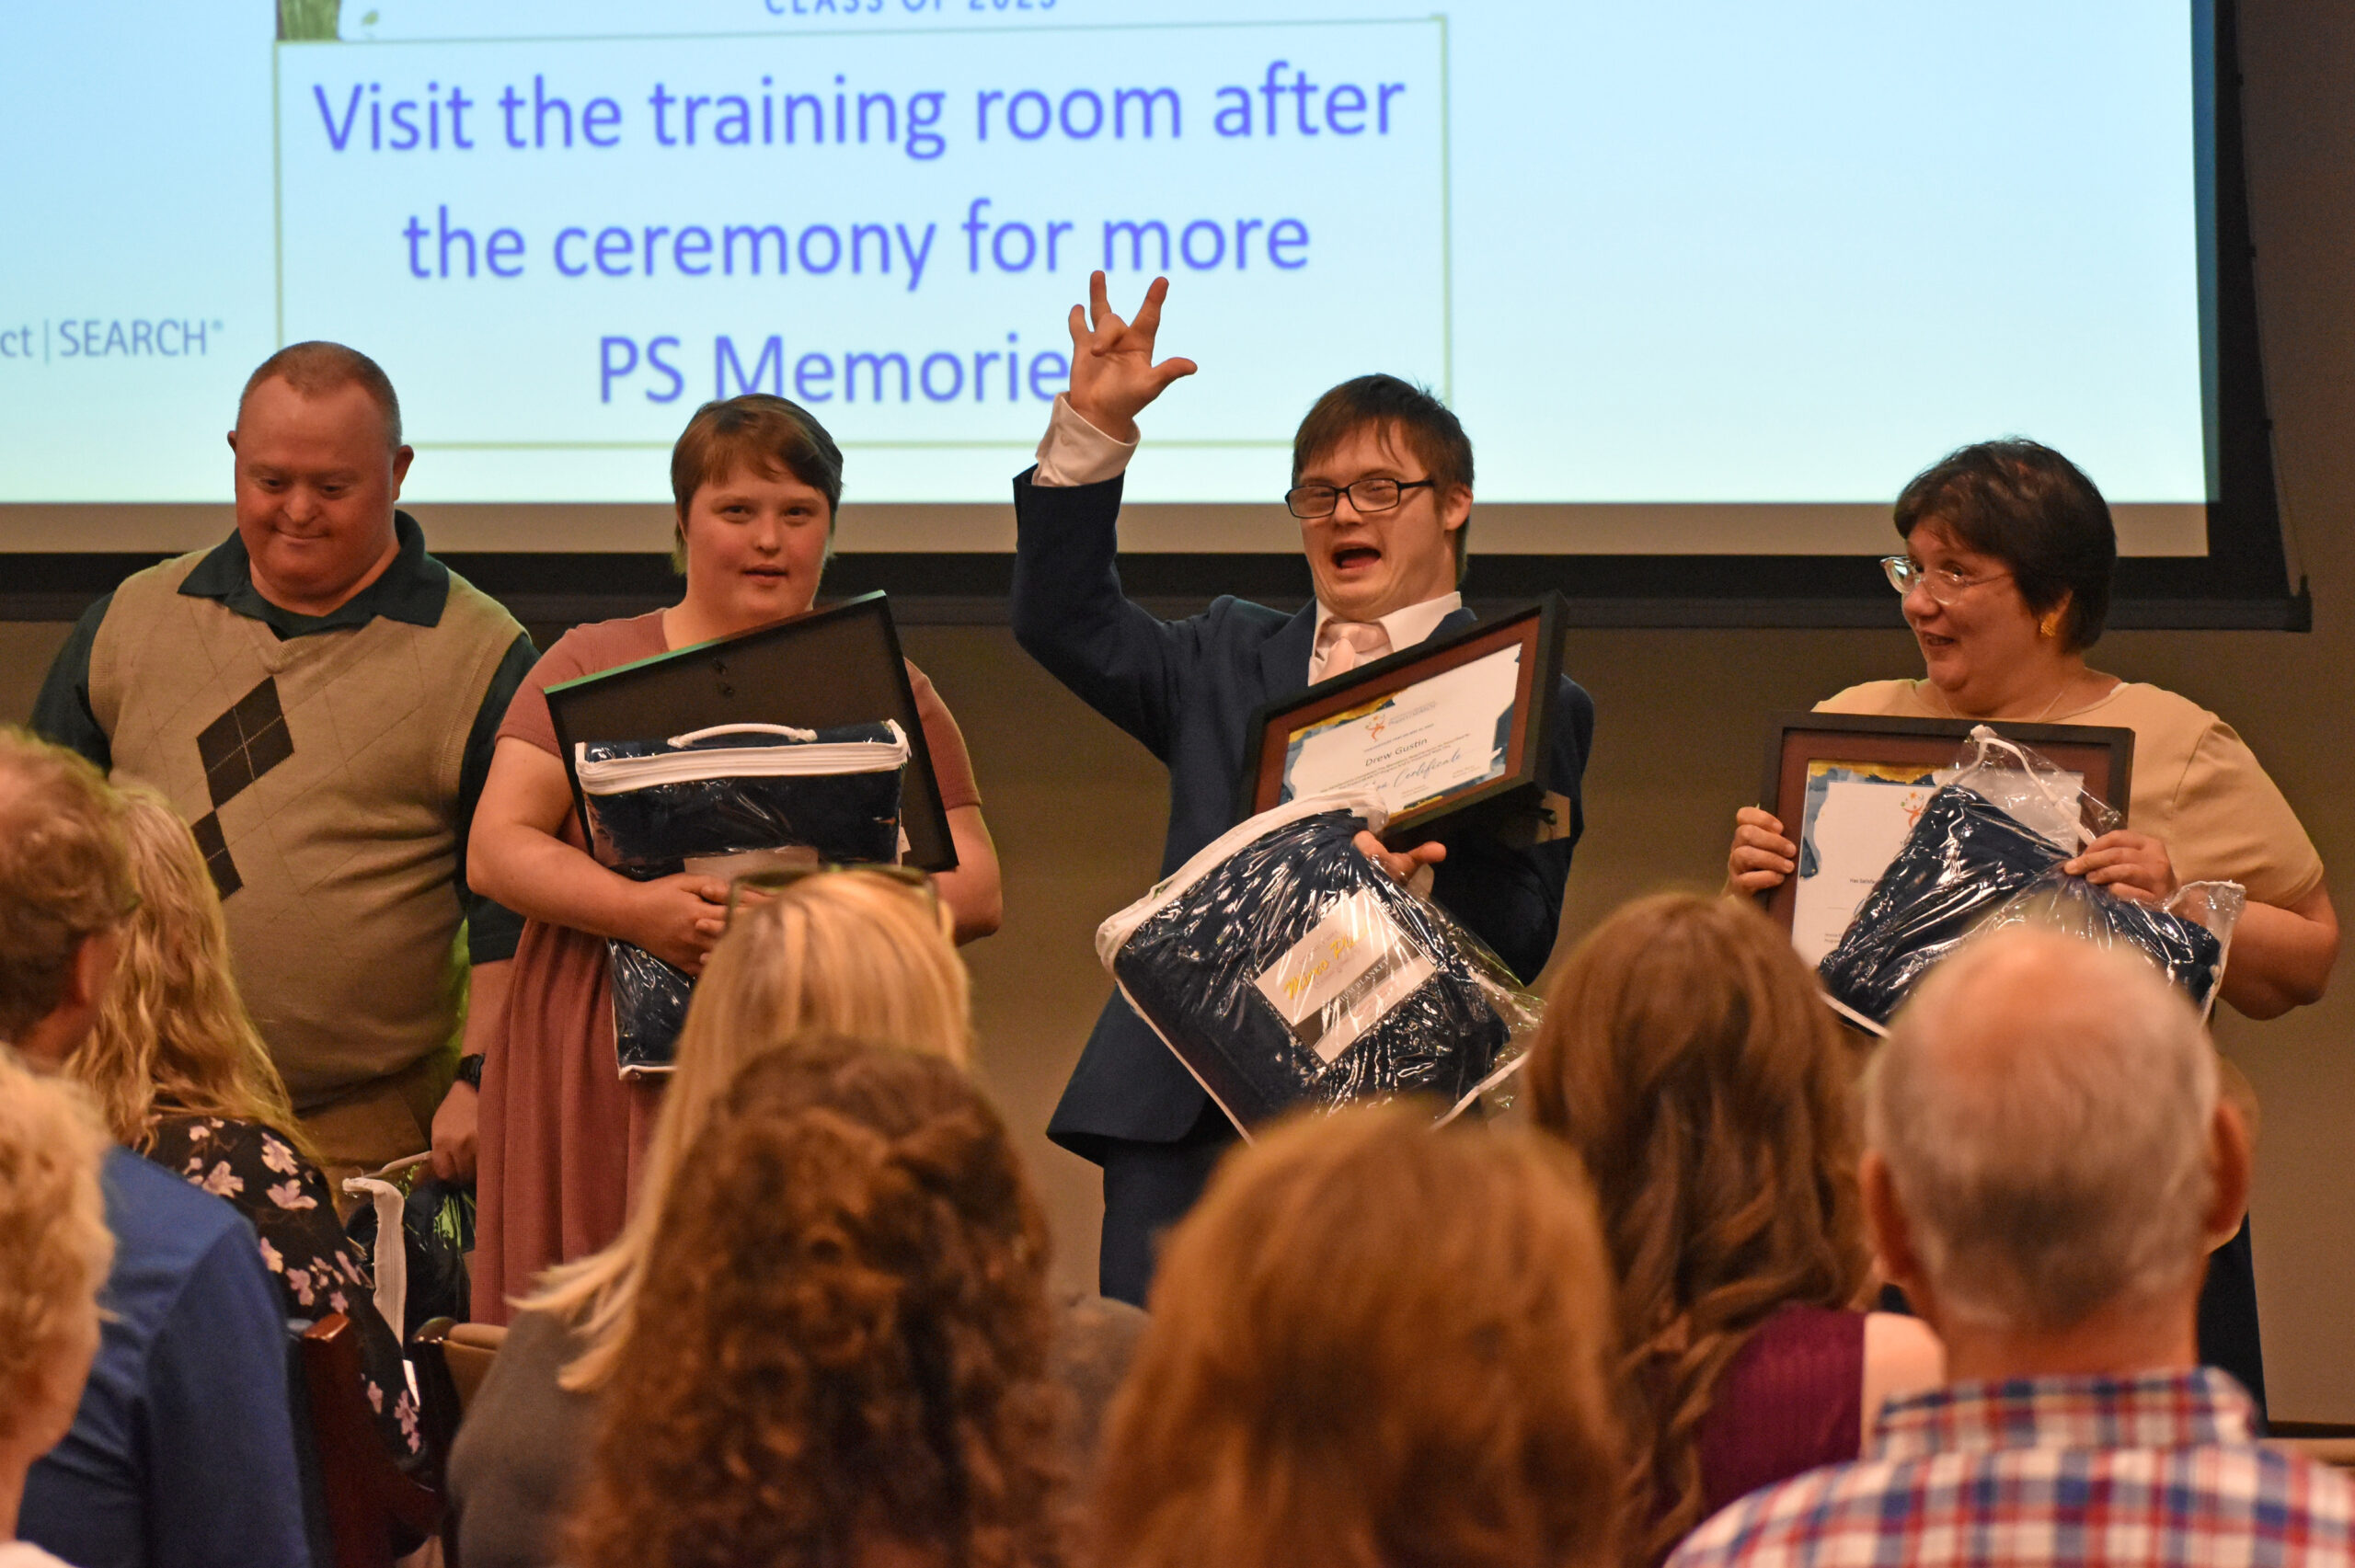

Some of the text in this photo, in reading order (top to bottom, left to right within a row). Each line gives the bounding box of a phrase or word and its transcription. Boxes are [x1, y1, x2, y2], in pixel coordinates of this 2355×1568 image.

[312, 59, 1406, 162] Visit the training room after
[402, 196, 1311, 288] the ceremony for more
[600, 332, 1069, 405] PS Memorie
[1365, 751, 1393, 767] Drew
[1395, 737, 1428, 755] Gustin
